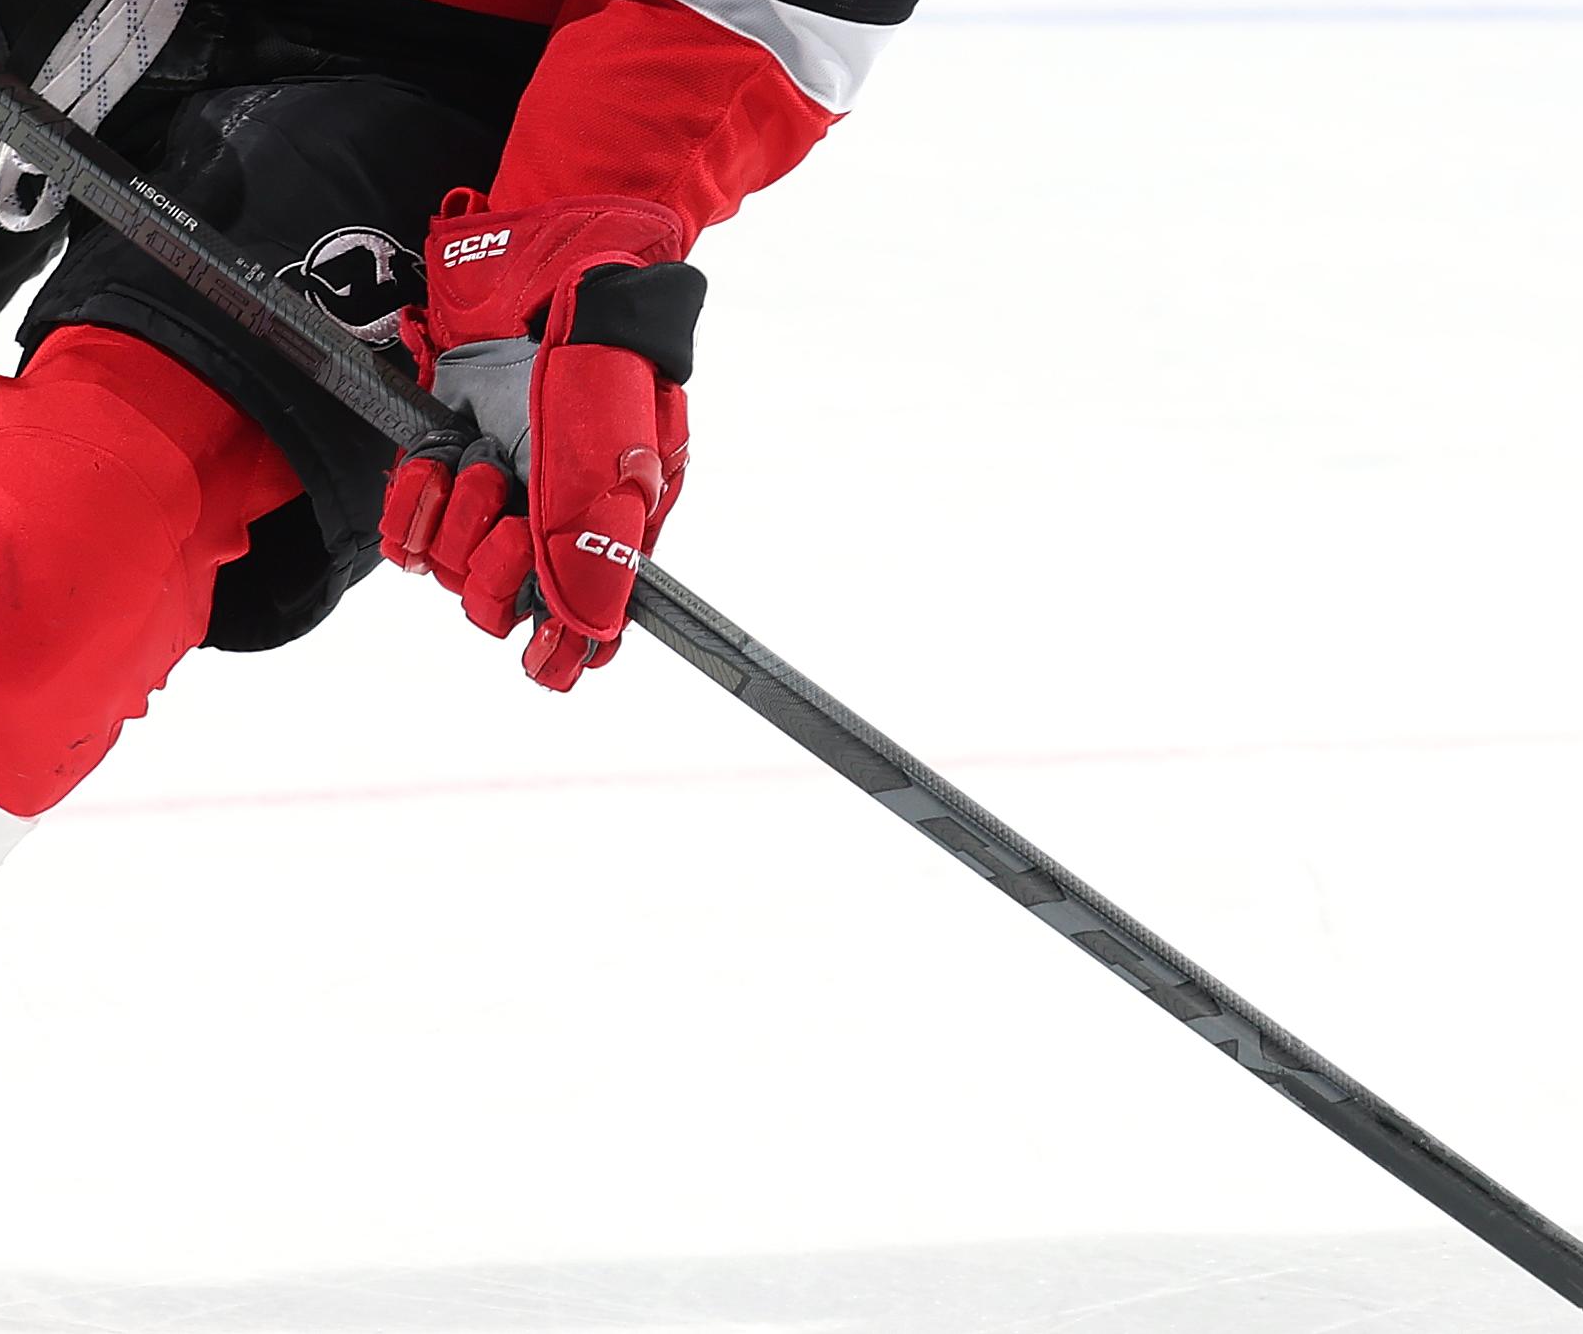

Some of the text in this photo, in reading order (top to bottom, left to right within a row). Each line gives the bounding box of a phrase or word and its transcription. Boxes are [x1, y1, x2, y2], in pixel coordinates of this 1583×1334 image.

[129, 175, 199, 233] HISCHIER
[443, 228, 511, 260] CCM
[458, 250, 487, 265] PRO
